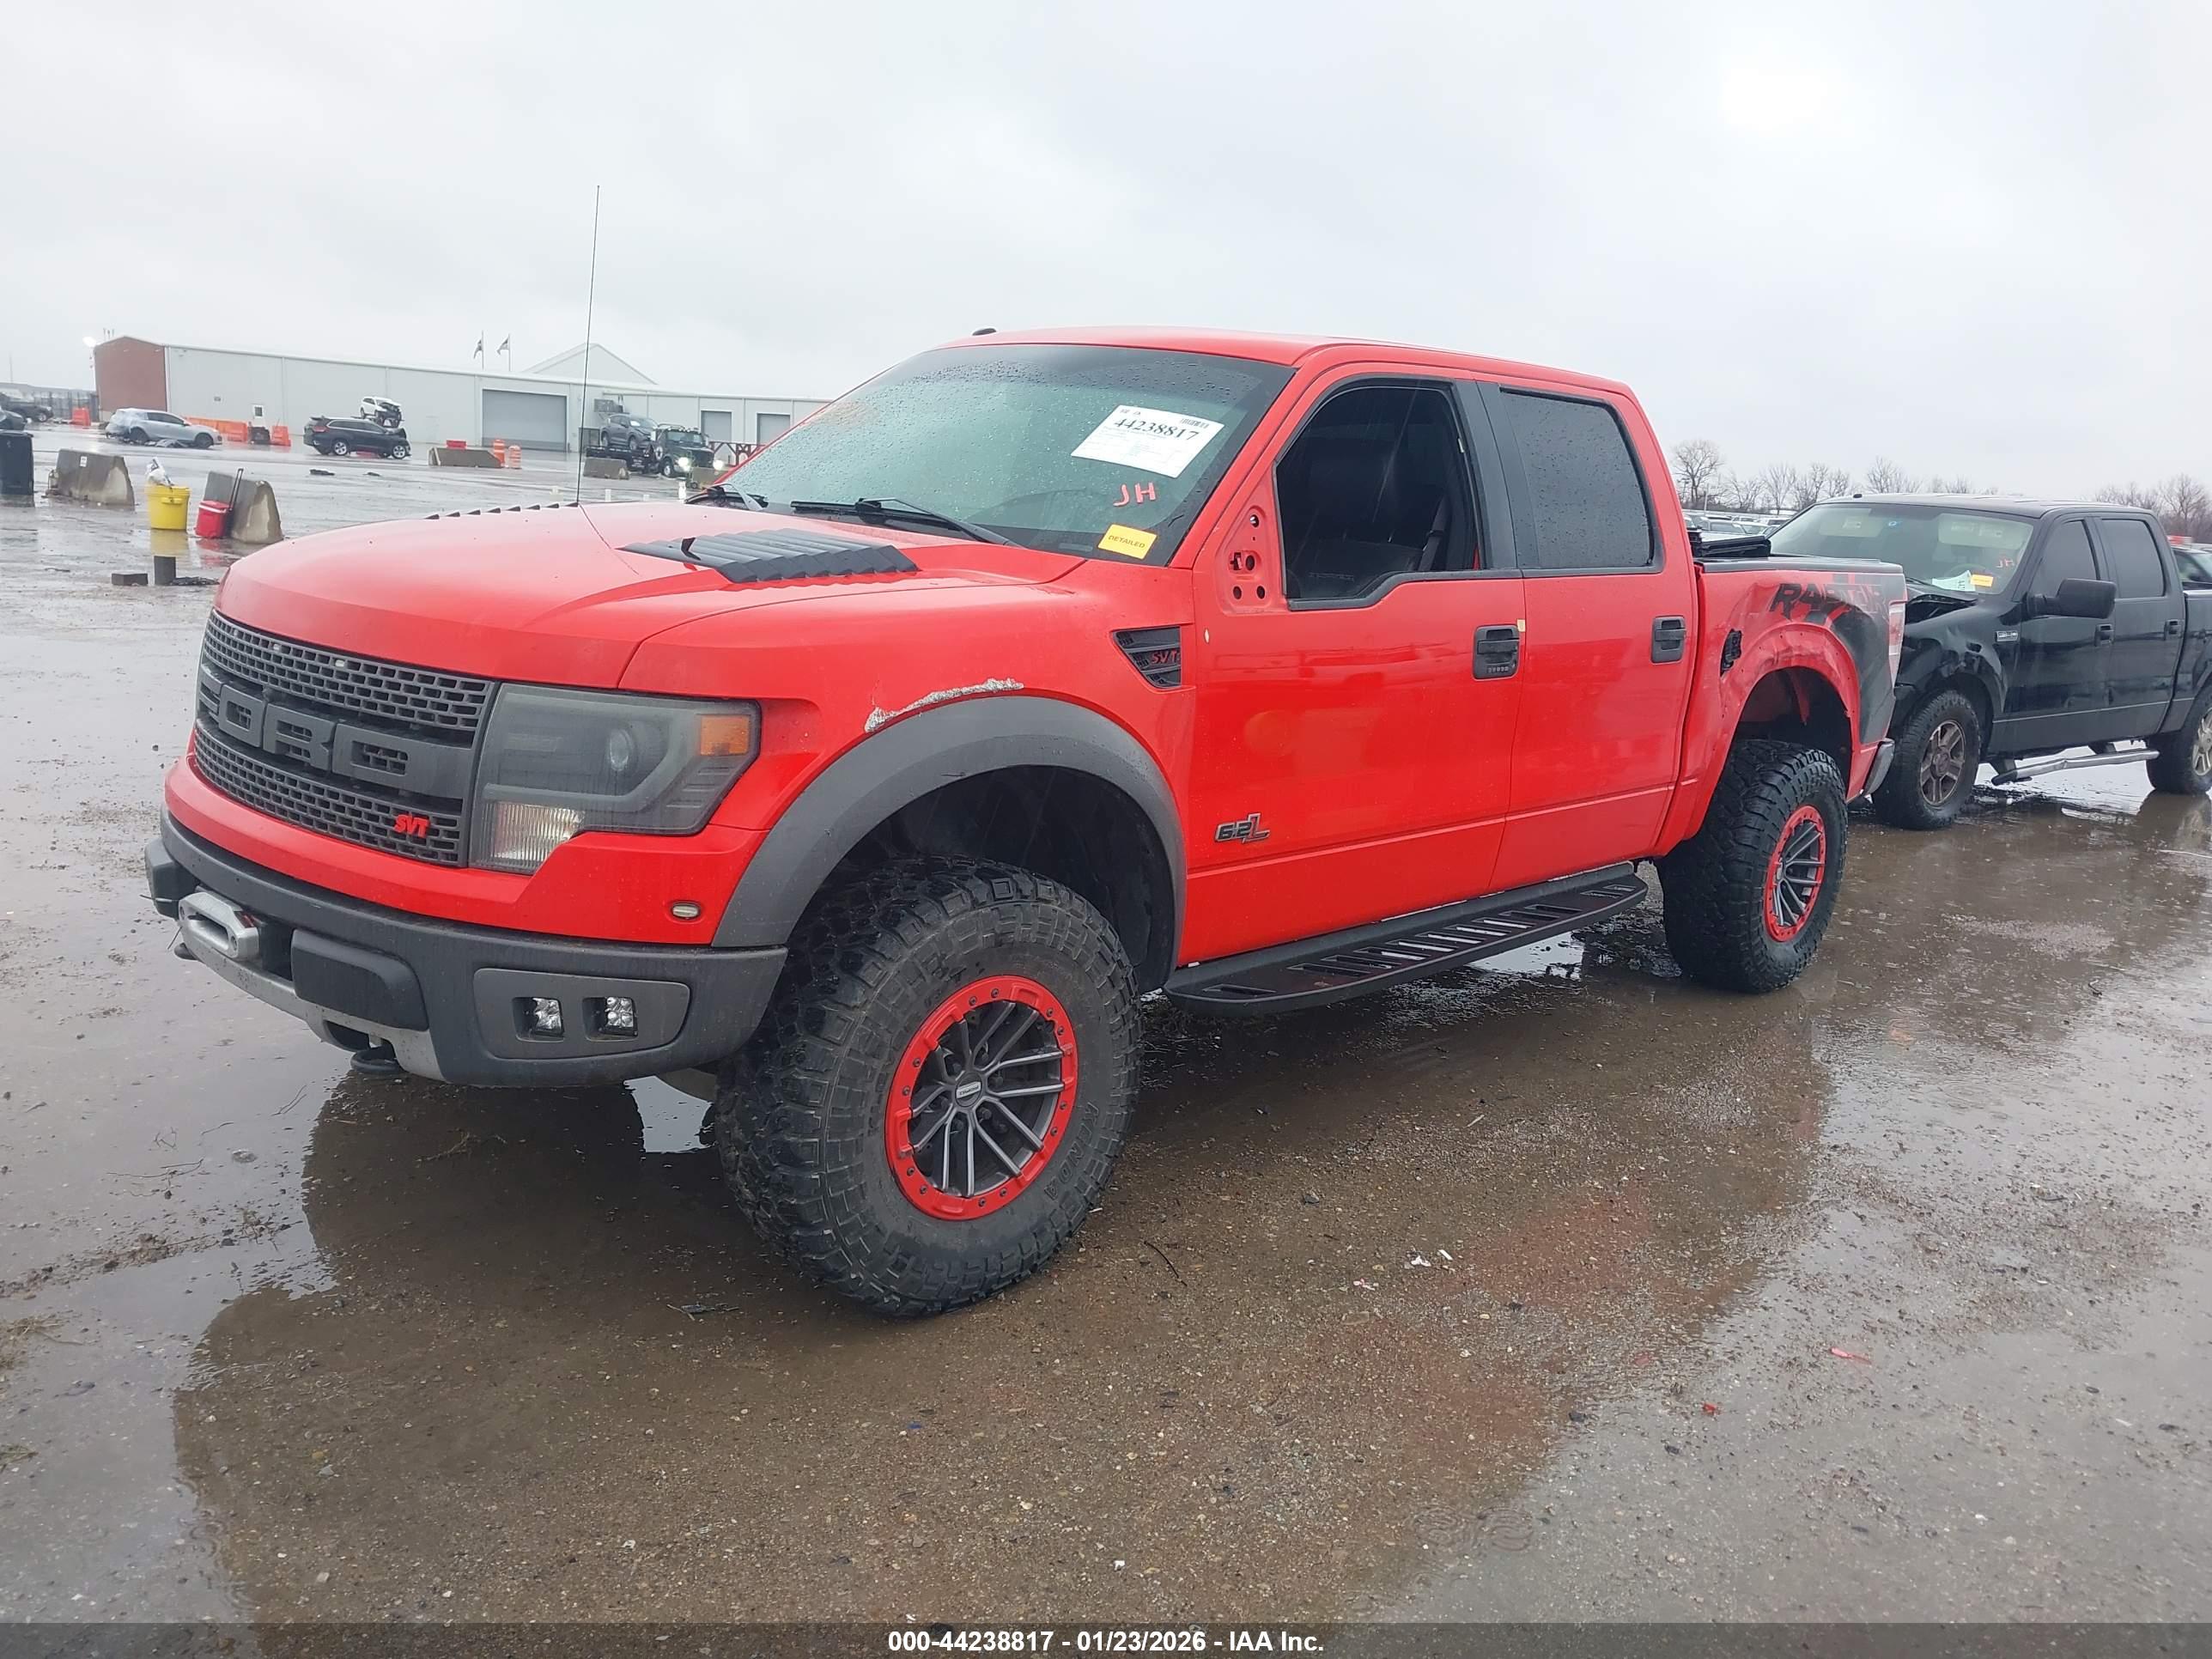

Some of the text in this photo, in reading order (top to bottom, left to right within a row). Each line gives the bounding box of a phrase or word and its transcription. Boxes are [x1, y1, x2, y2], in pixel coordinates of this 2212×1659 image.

[1114, 418, 1200, 441] 44238817
[1108, 535, 1146, 549] DETAILED
[393, 814, 428, 839] SVT
